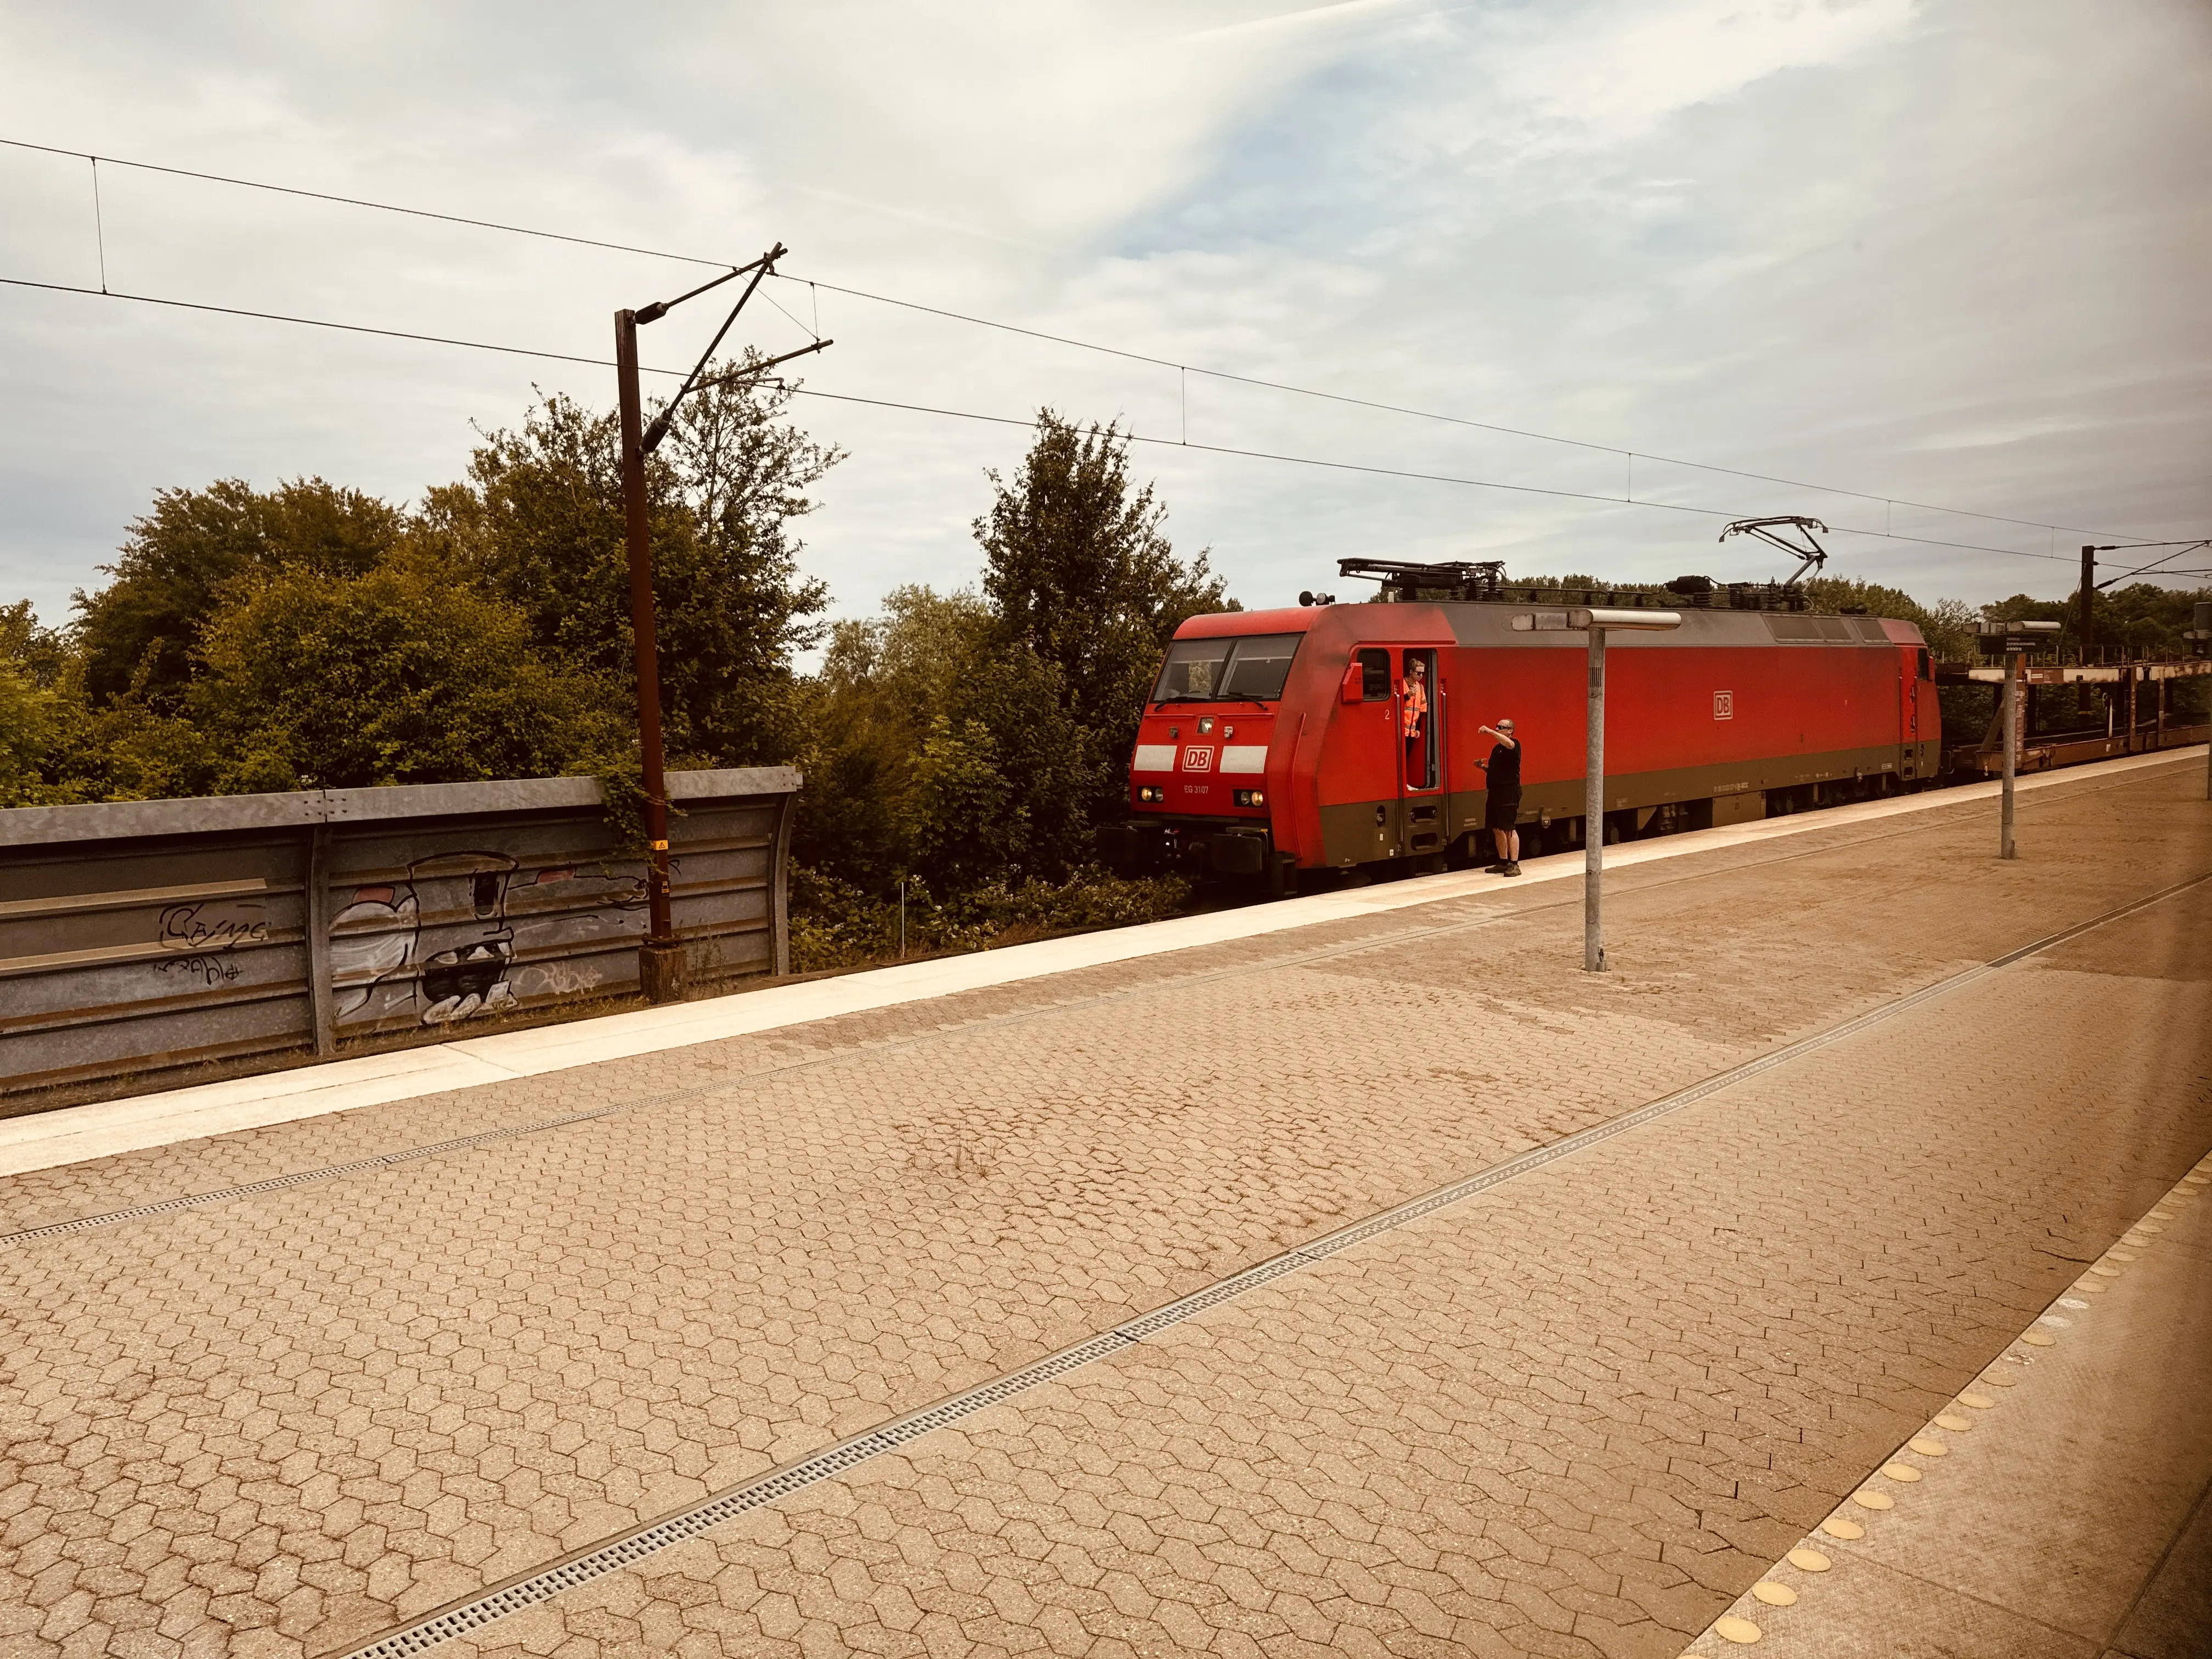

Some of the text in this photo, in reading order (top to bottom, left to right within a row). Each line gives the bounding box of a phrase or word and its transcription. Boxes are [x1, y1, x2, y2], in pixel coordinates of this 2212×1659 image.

[1717, 697, 1729, 713] DB
[1385, 709, 1390, 720] 2
[1187, 751, 1208, 766] DB
[1184, 785, 1209, 794] EG 3107
